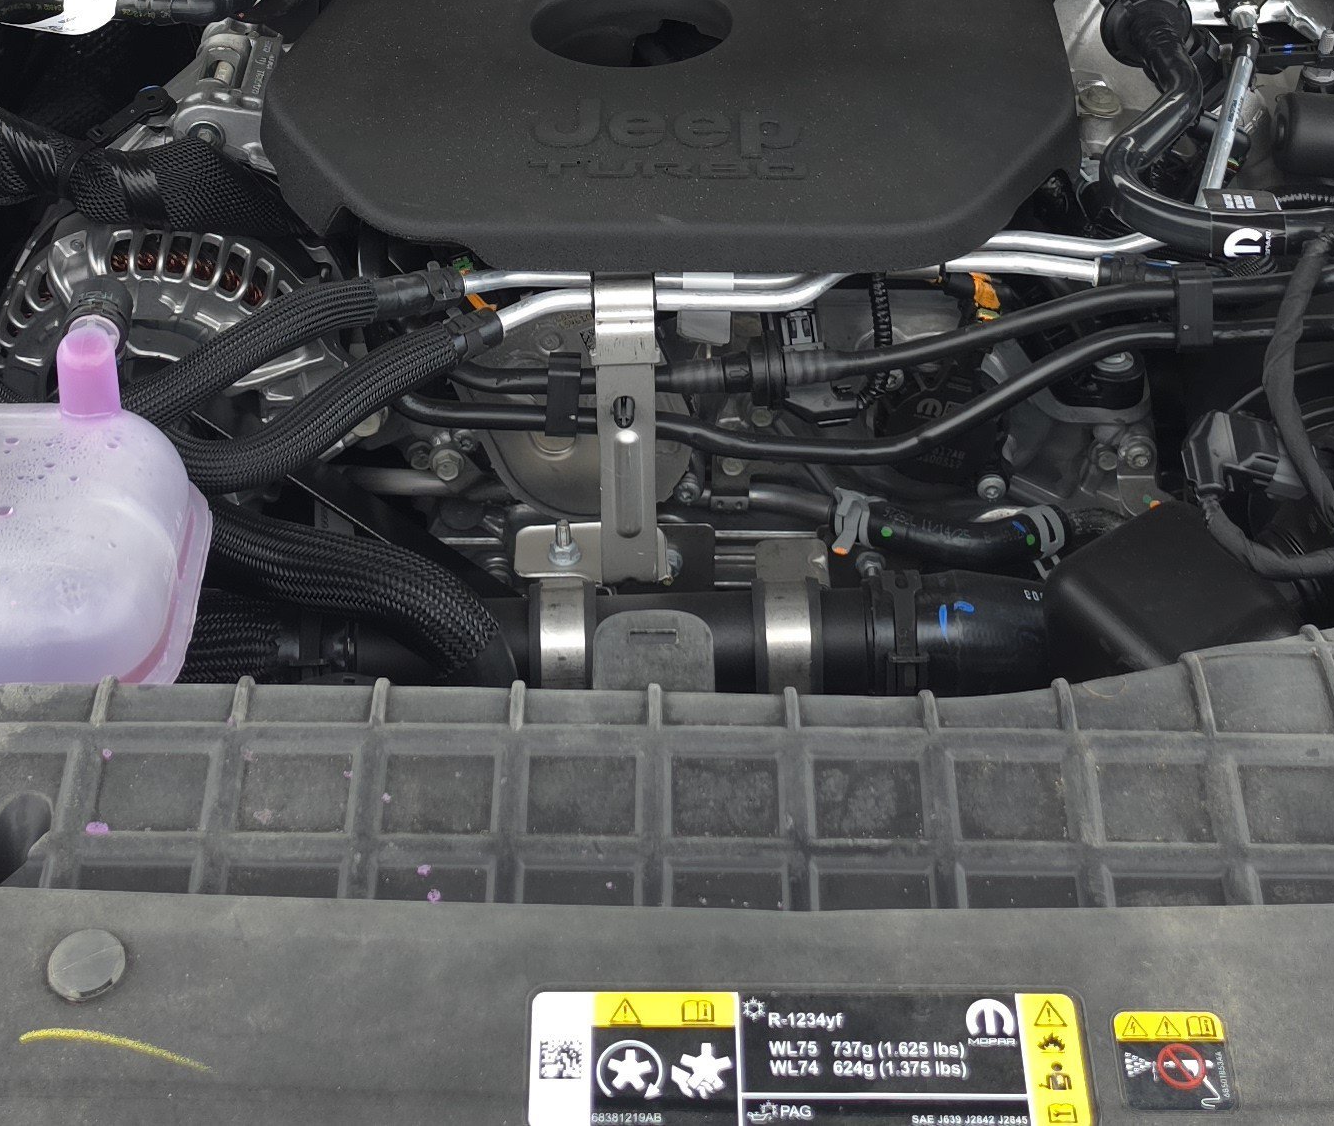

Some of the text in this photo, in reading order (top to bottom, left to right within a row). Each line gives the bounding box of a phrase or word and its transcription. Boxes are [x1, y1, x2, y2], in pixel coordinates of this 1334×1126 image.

[532, 96, 804, 160] Jeep
[527, 160, 807, 180] TURBO
[768, 1012, 843, 1030] R-1234yf
[769, 1040, 965, 1057] WL75 737g (1.625 lbs)
[967, 1037, 1016, 1047] MOPAR
[770, 1059, 967, 1078] WL74 624g (1.375 lbs)
[590, 1111, 663, 1123] 68381219AB
[780, 1104, 812, 1119] PAG
[911, 1114, 935, 1125] SAE
[937, 1114, 962, 1125] J639
[965, 1114, 995, 1125] J2842
